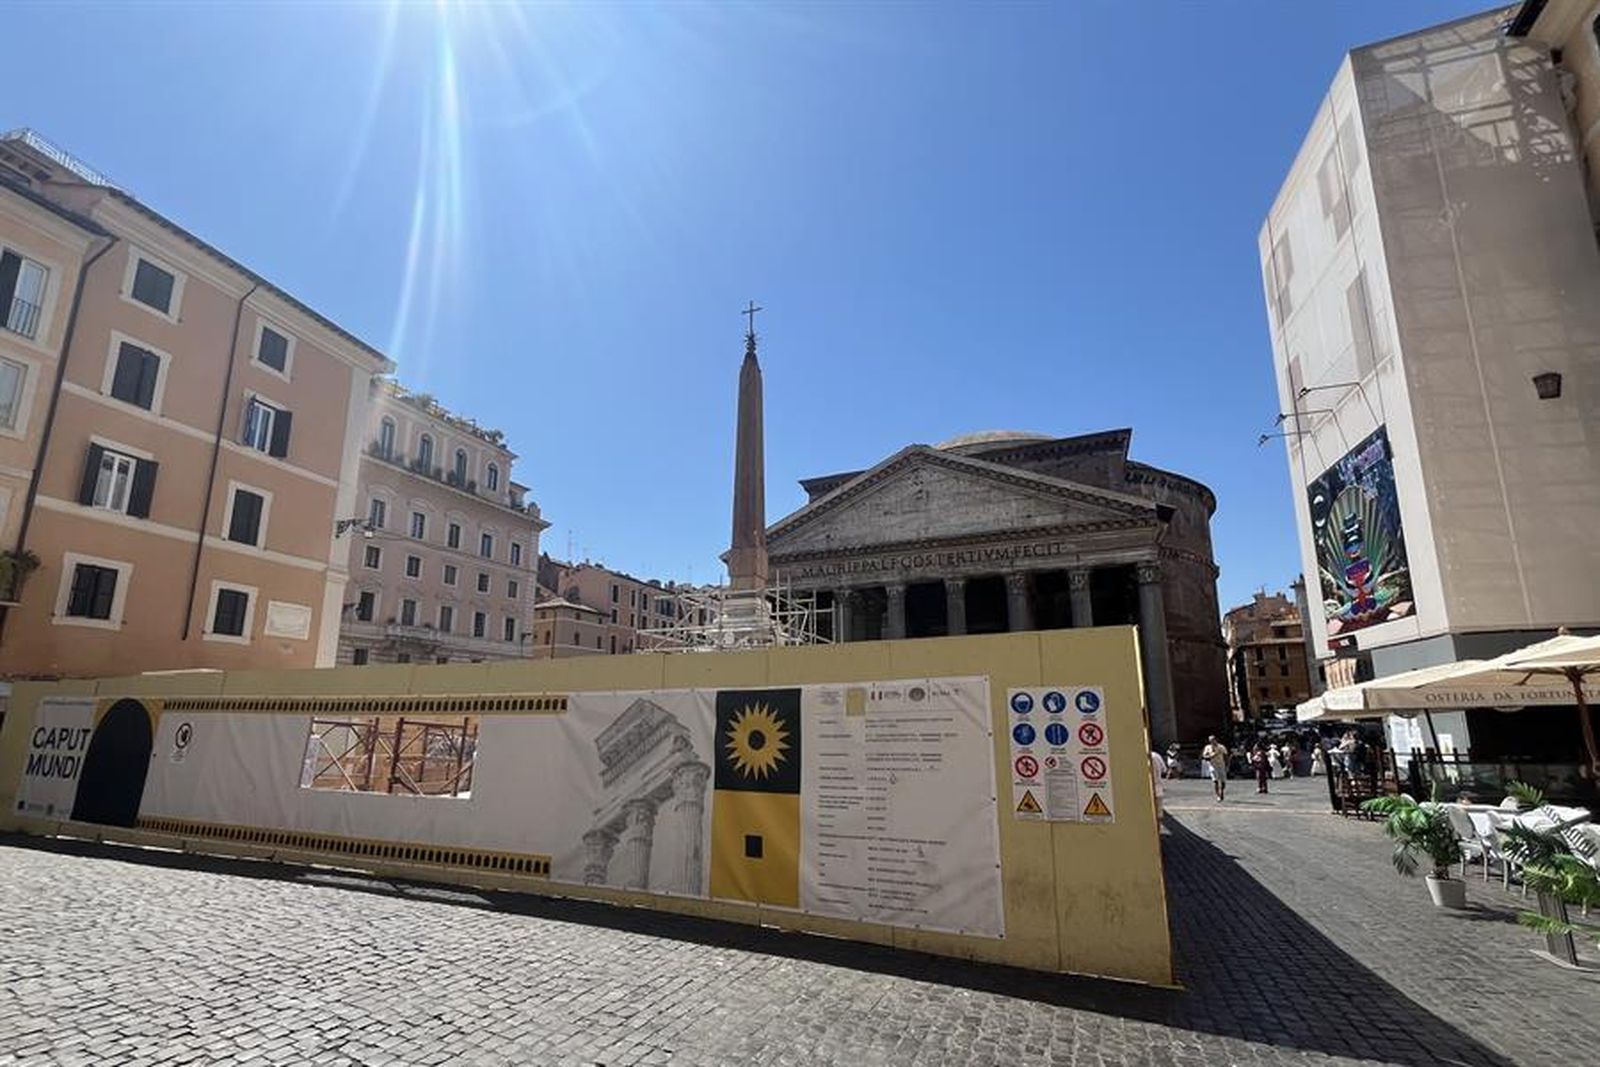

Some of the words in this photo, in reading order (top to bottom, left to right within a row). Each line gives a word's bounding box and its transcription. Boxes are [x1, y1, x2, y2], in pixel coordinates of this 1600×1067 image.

[1425, 690, 1485, 702] OSTERIA
[1493, 690, 1513, 701] DA
[32, 727, 91, 750] CAPUT
[26, 753, 82, 779] MUNDI
